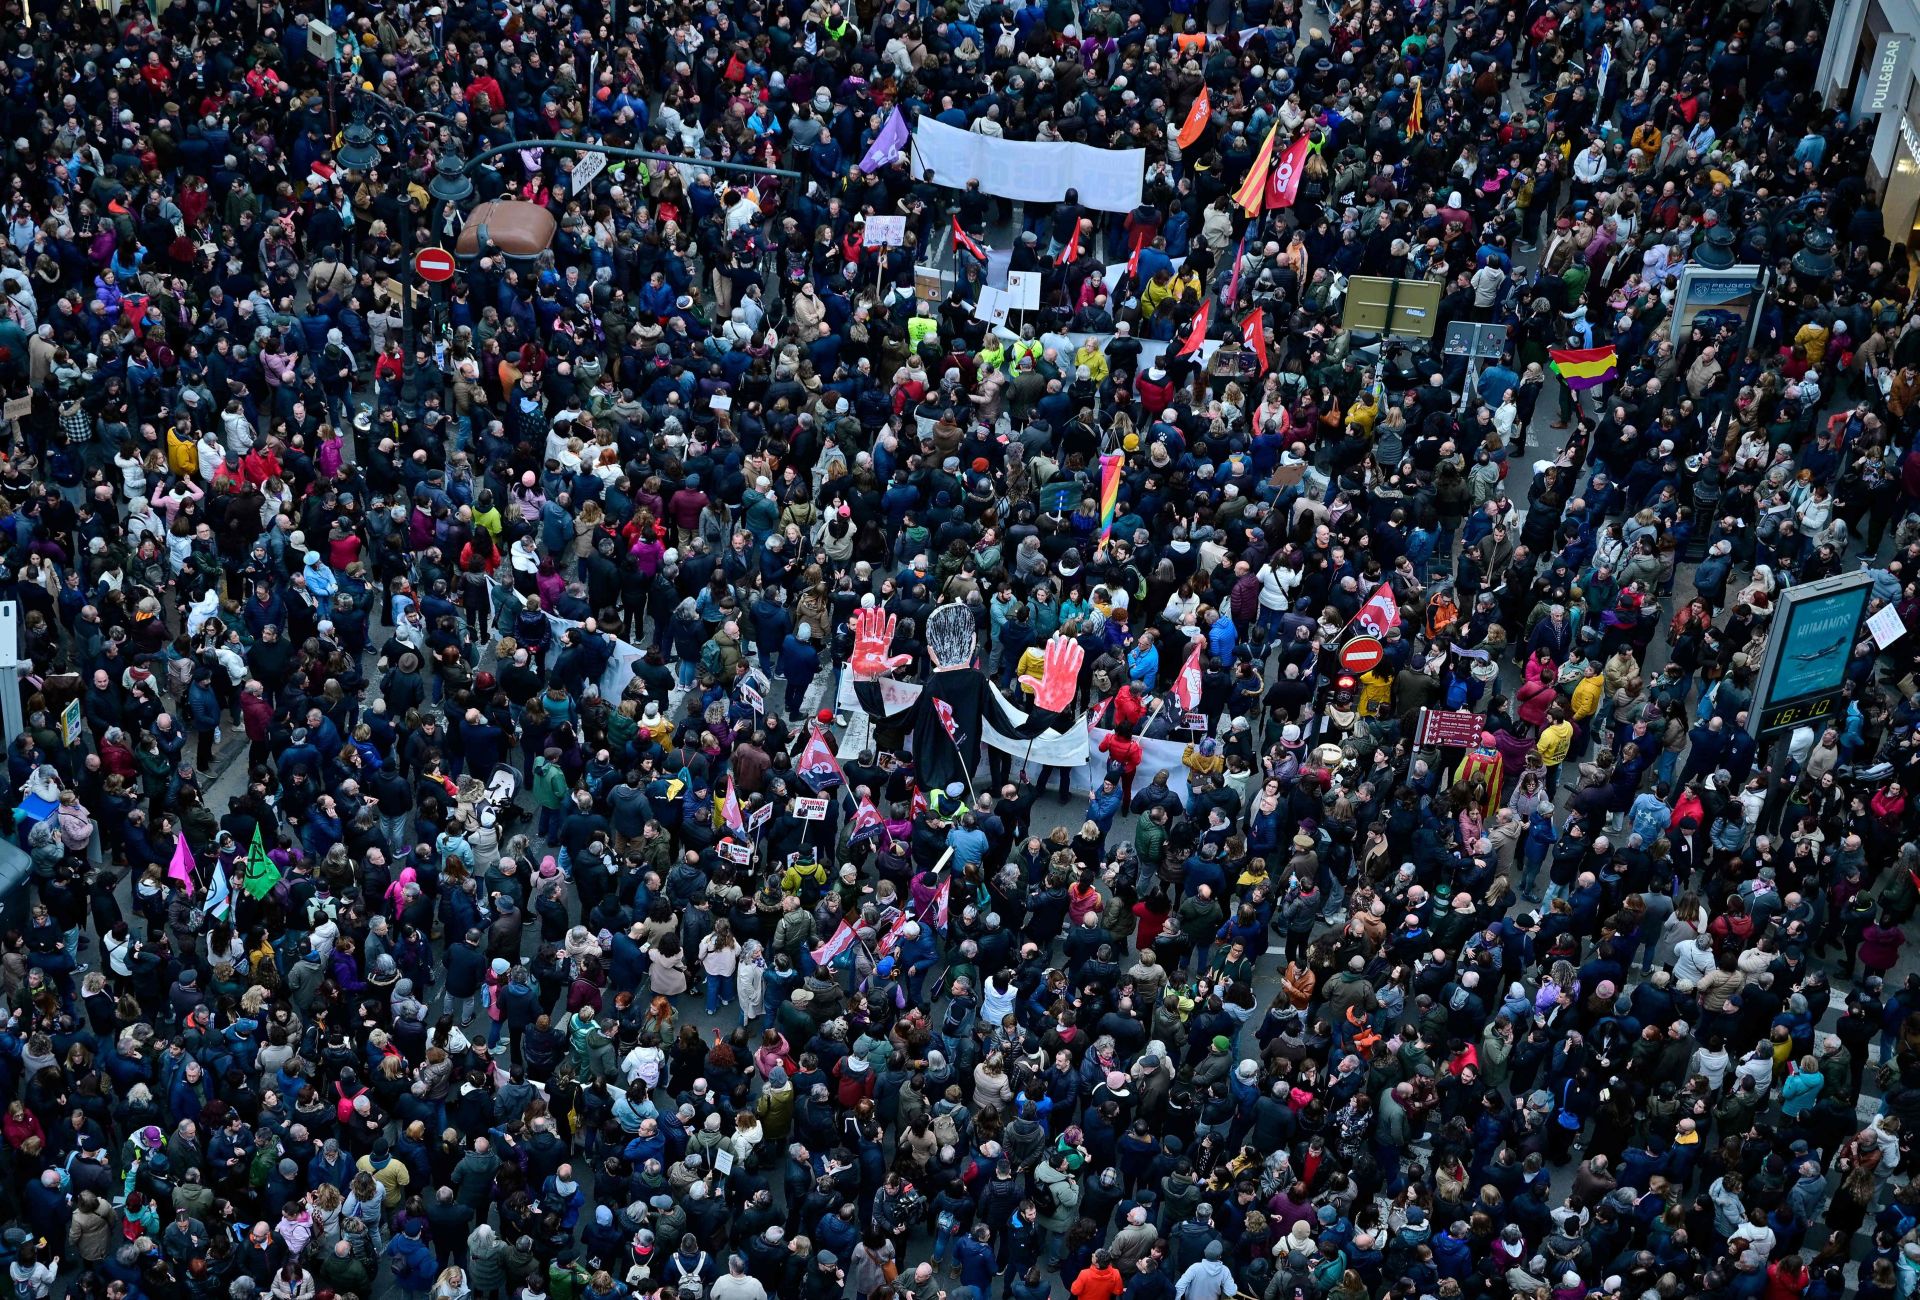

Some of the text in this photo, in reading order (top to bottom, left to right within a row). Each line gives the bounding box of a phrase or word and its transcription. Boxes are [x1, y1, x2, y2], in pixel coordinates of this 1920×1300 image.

[1872, 41, 1900, 108] PULL&BEAR
[1797, 613, 1851, 638] HUMANOS
[1773, 700, 1831, 726] 18:10
